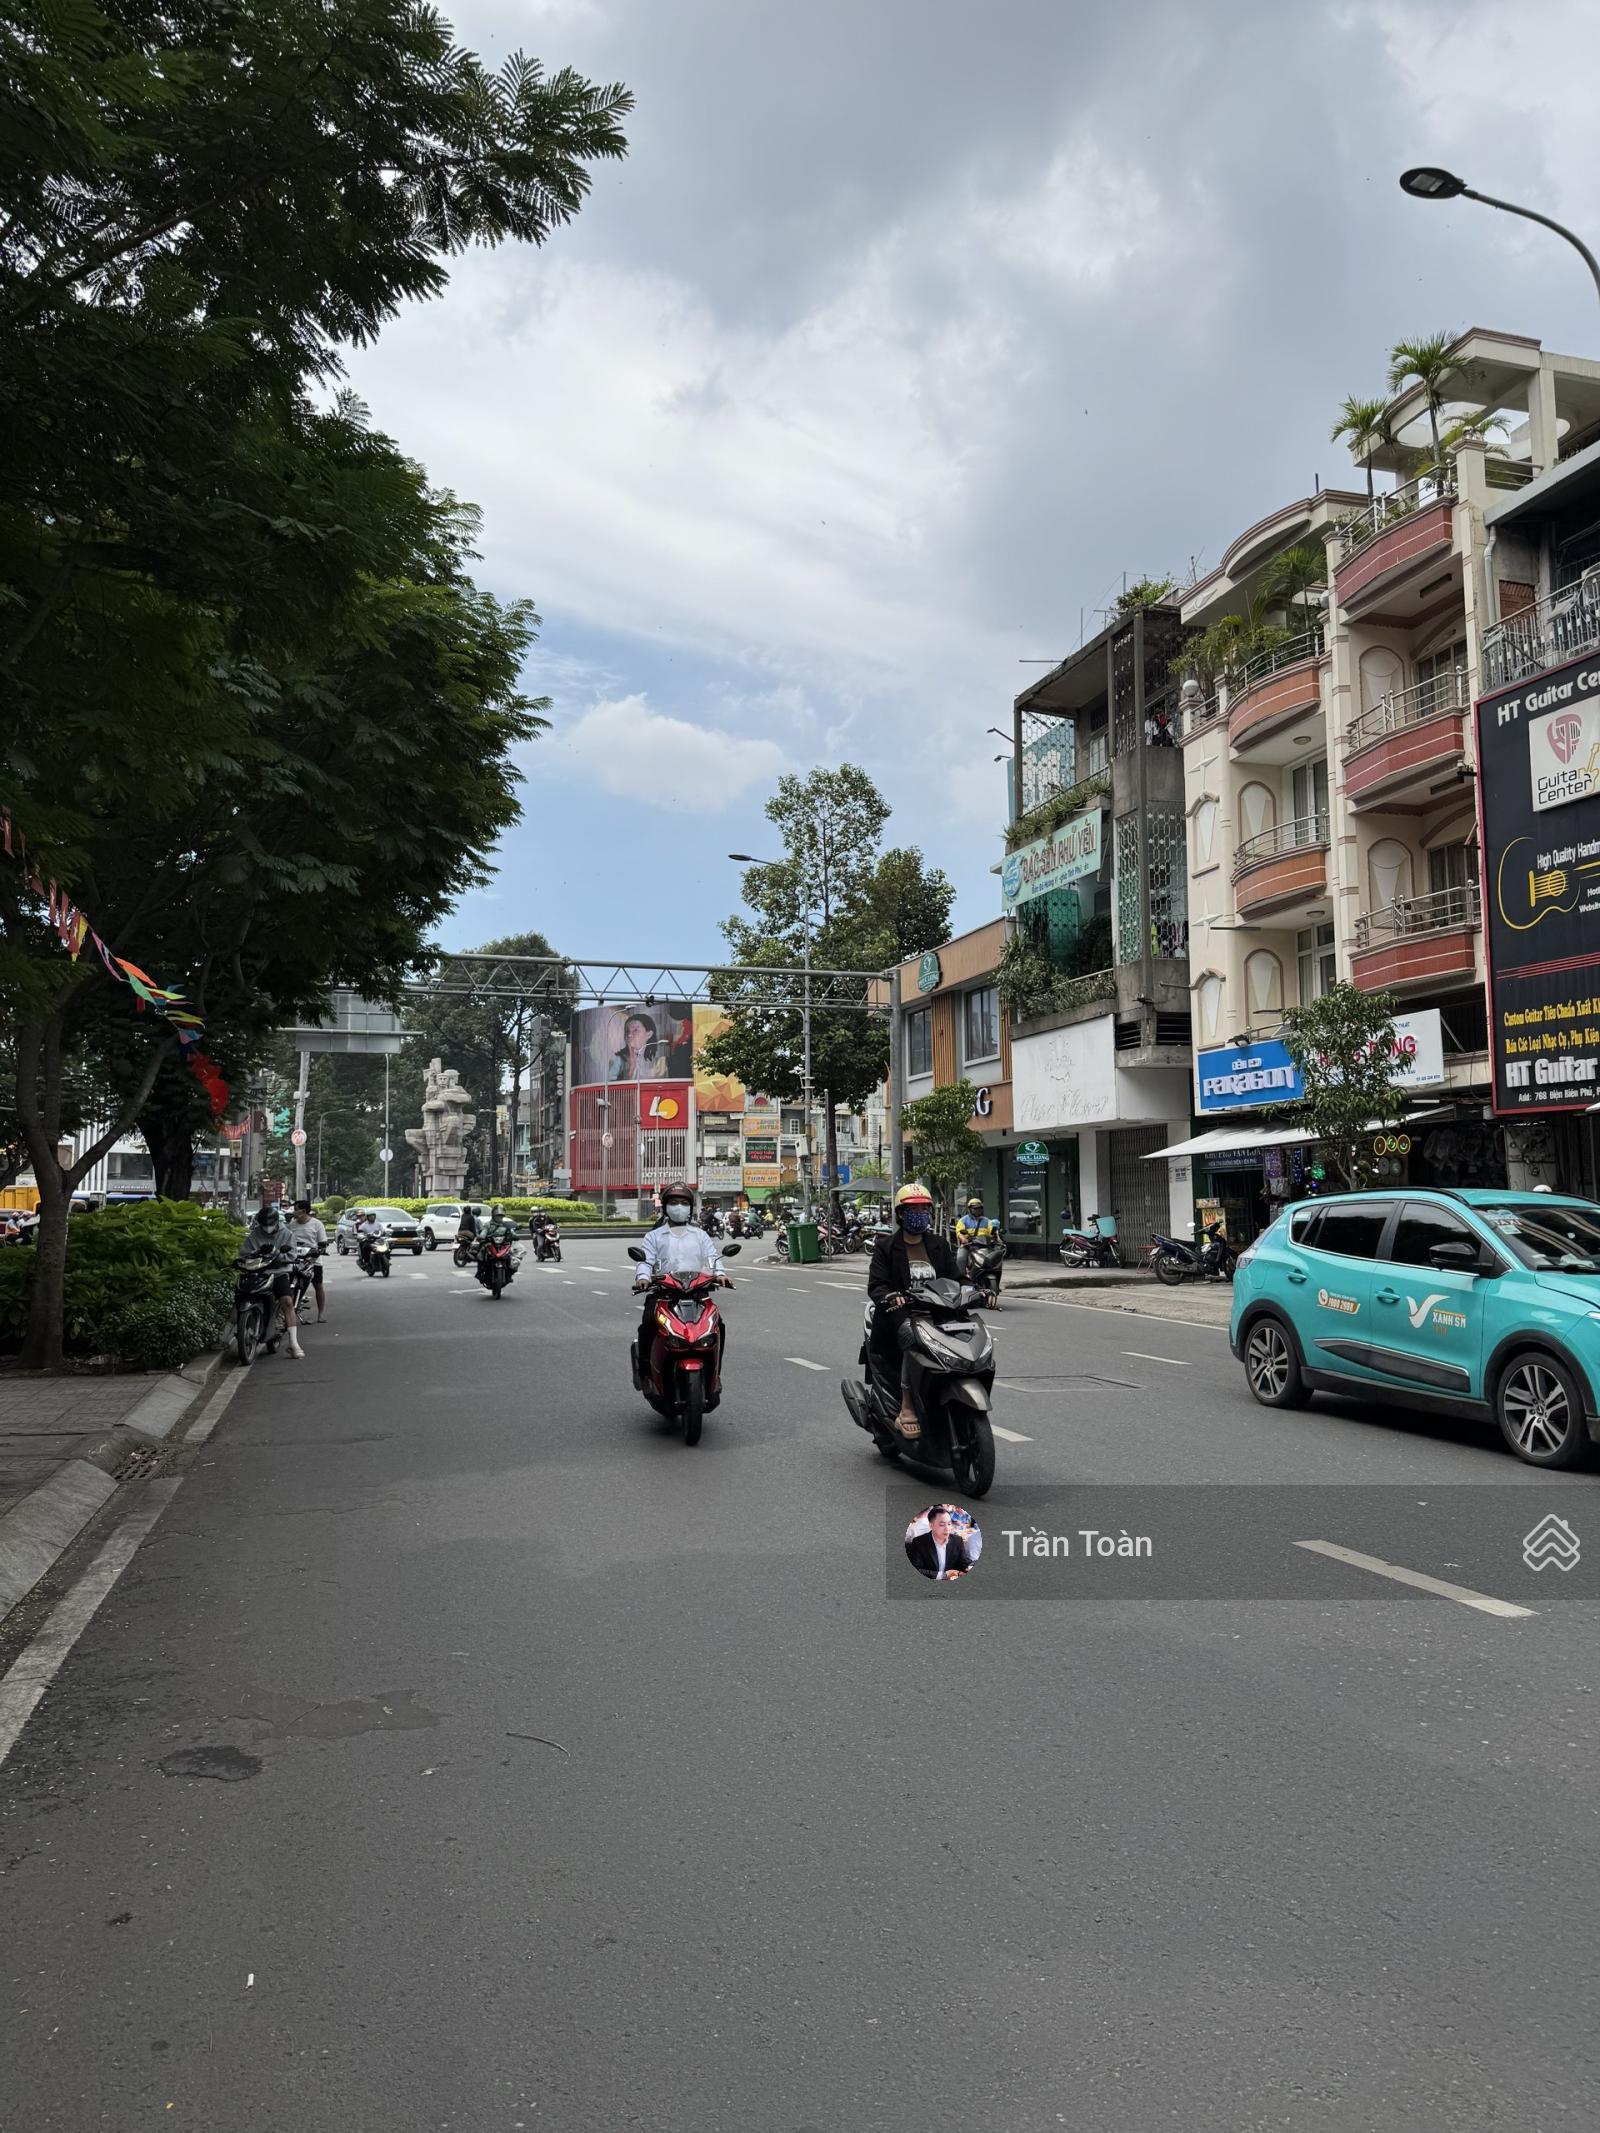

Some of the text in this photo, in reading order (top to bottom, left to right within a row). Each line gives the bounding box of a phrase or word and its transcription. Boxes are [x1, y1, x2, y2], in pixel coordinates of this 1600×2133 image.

[1497, 700, 1521, 727] HT
[1525, 682, 1574, 712] Guitar
[1538, 778, 1592, 804] Center
[1537, 852, 1552, 871] High
[1552, 846, 1576, 868] Quality
[1504, 1011, 1525, 1026] Custom
[1525, 1008, 1543, 1023] Guitar
[1505, 1038, 1517, 1053] Bán
[1518, 1036, 1528, 1052] Các
[1528, 1035, 1541, 1052] Loại
[1542, 1033, 1557, 1051] Nhạc
[1570, 1029, 1583, 1048] Phụ
[1505, 1056, 1598, 1088] HT Guitar
[1518, 1093, 1532, 1102] Add:
[1432, 1311, 1466, 1329] XANH SM
